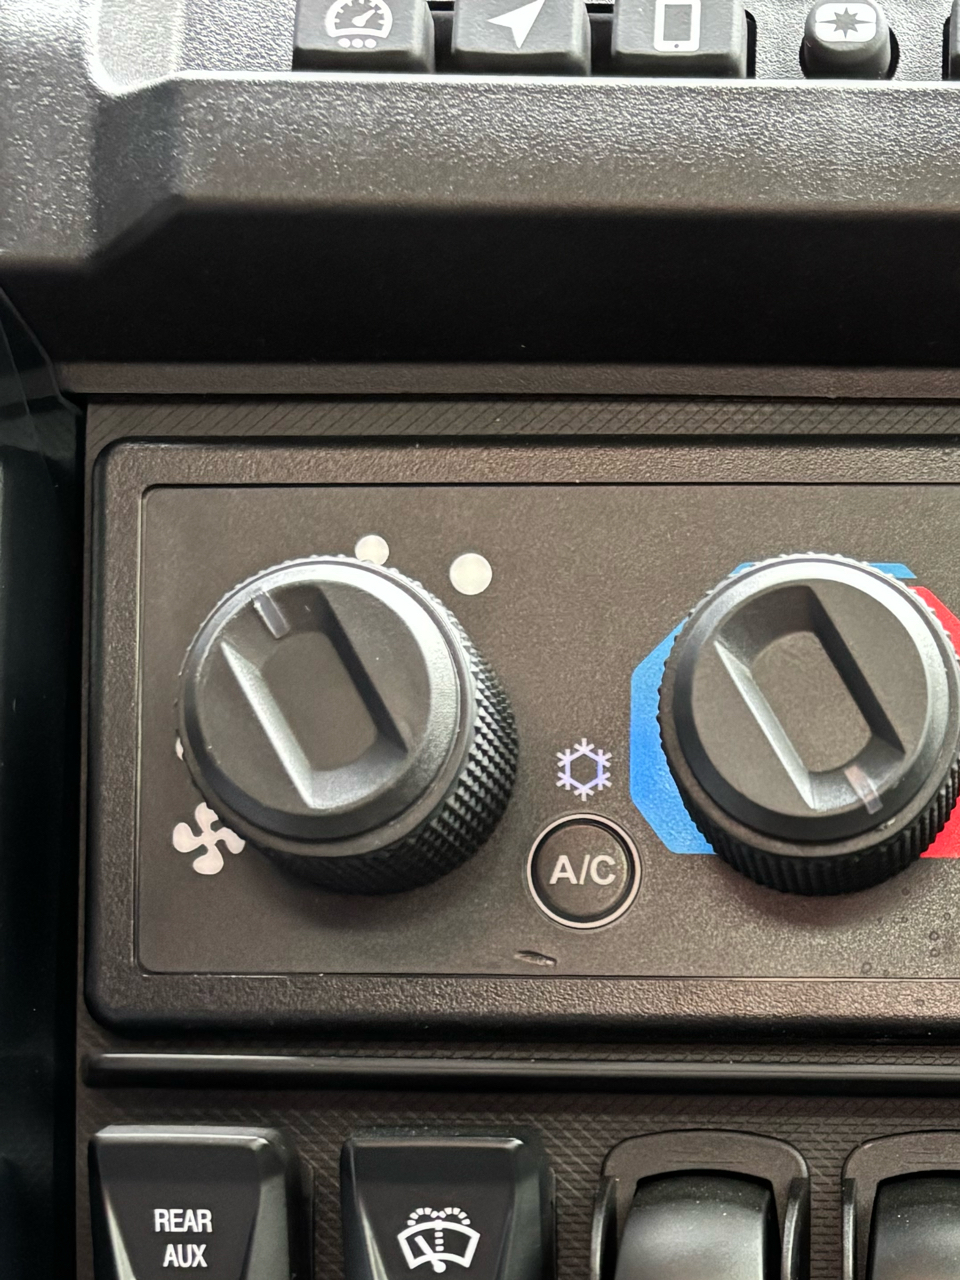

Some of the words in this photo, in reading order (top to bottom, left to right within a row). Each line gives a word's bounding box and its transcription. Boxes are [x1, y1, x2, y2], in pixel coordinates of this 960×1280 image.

[549, 854, 617, 886] A/C
[154, 1208, 213, 1233] REAR
[162, 1243, 208, 1268] AUX
